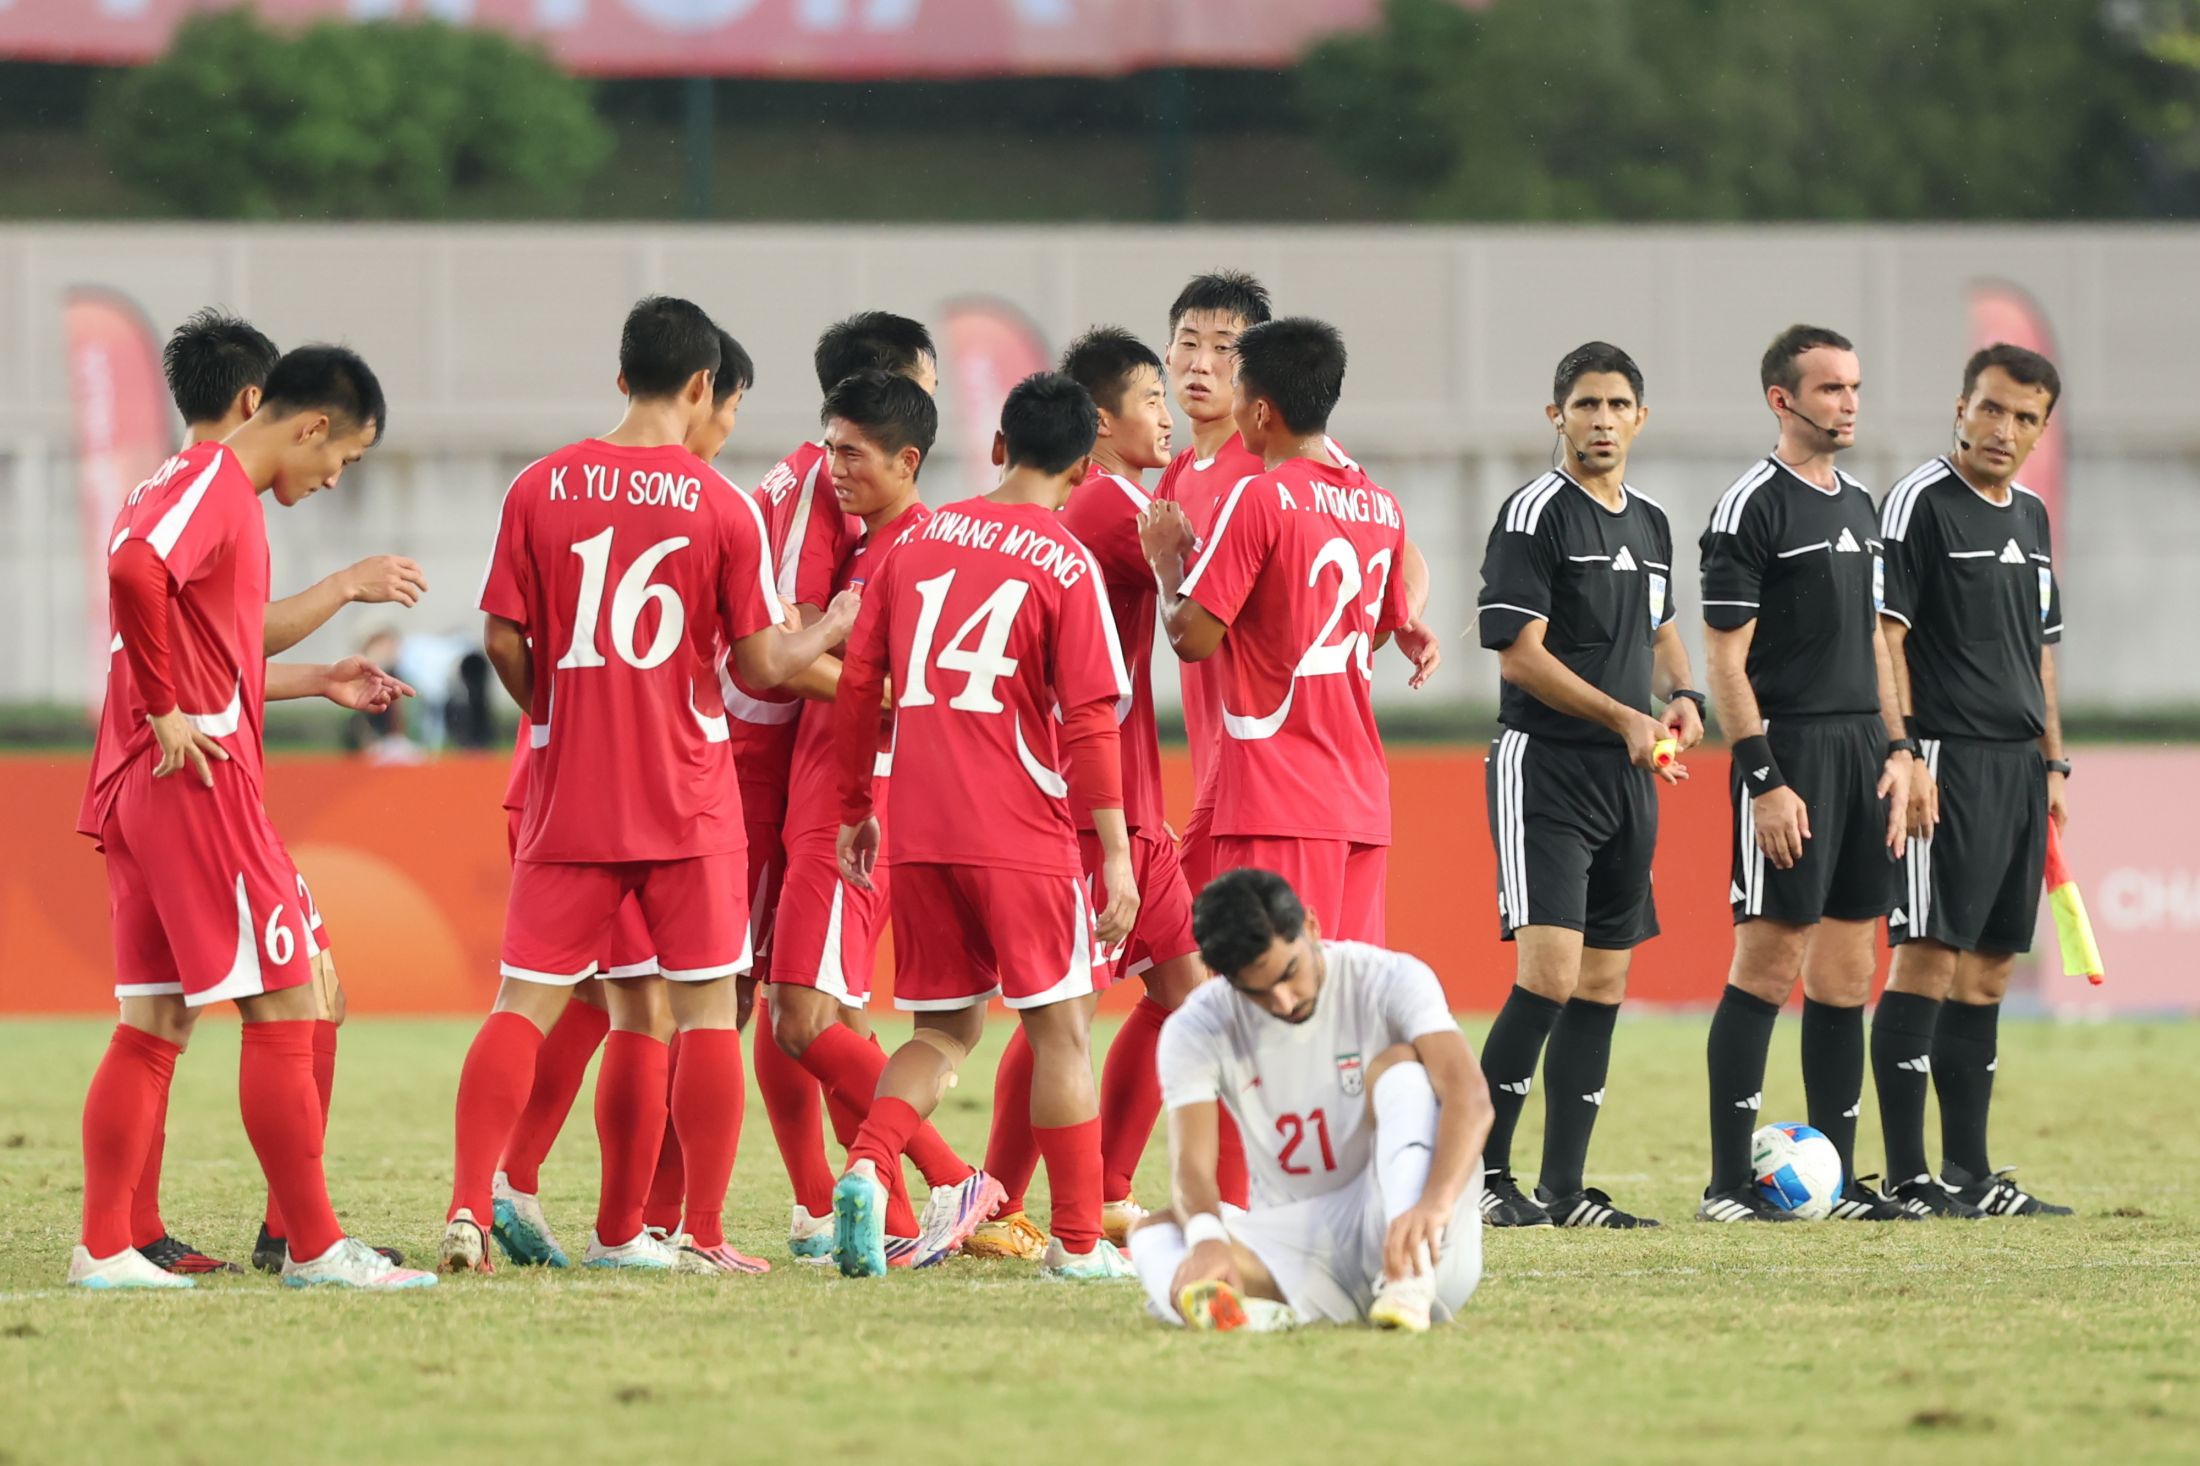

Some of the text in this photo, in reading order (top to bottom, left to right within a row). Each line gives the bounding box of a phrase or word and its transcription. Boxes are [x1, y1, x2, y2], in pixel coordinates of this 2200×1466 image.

[550, 464, 701, 512] K. YU SONG
[922, 511, 1003, 550] KWANG
[999, 525, 1088, 589] MYONG
[557, 525, 690, 670] 16
[1296, 537, 1392, 681] 23
[898, 568, 1030, 714] 14
[265, 903, 295, 966] 6
[1275, 1107, 1337, 1175] 21
